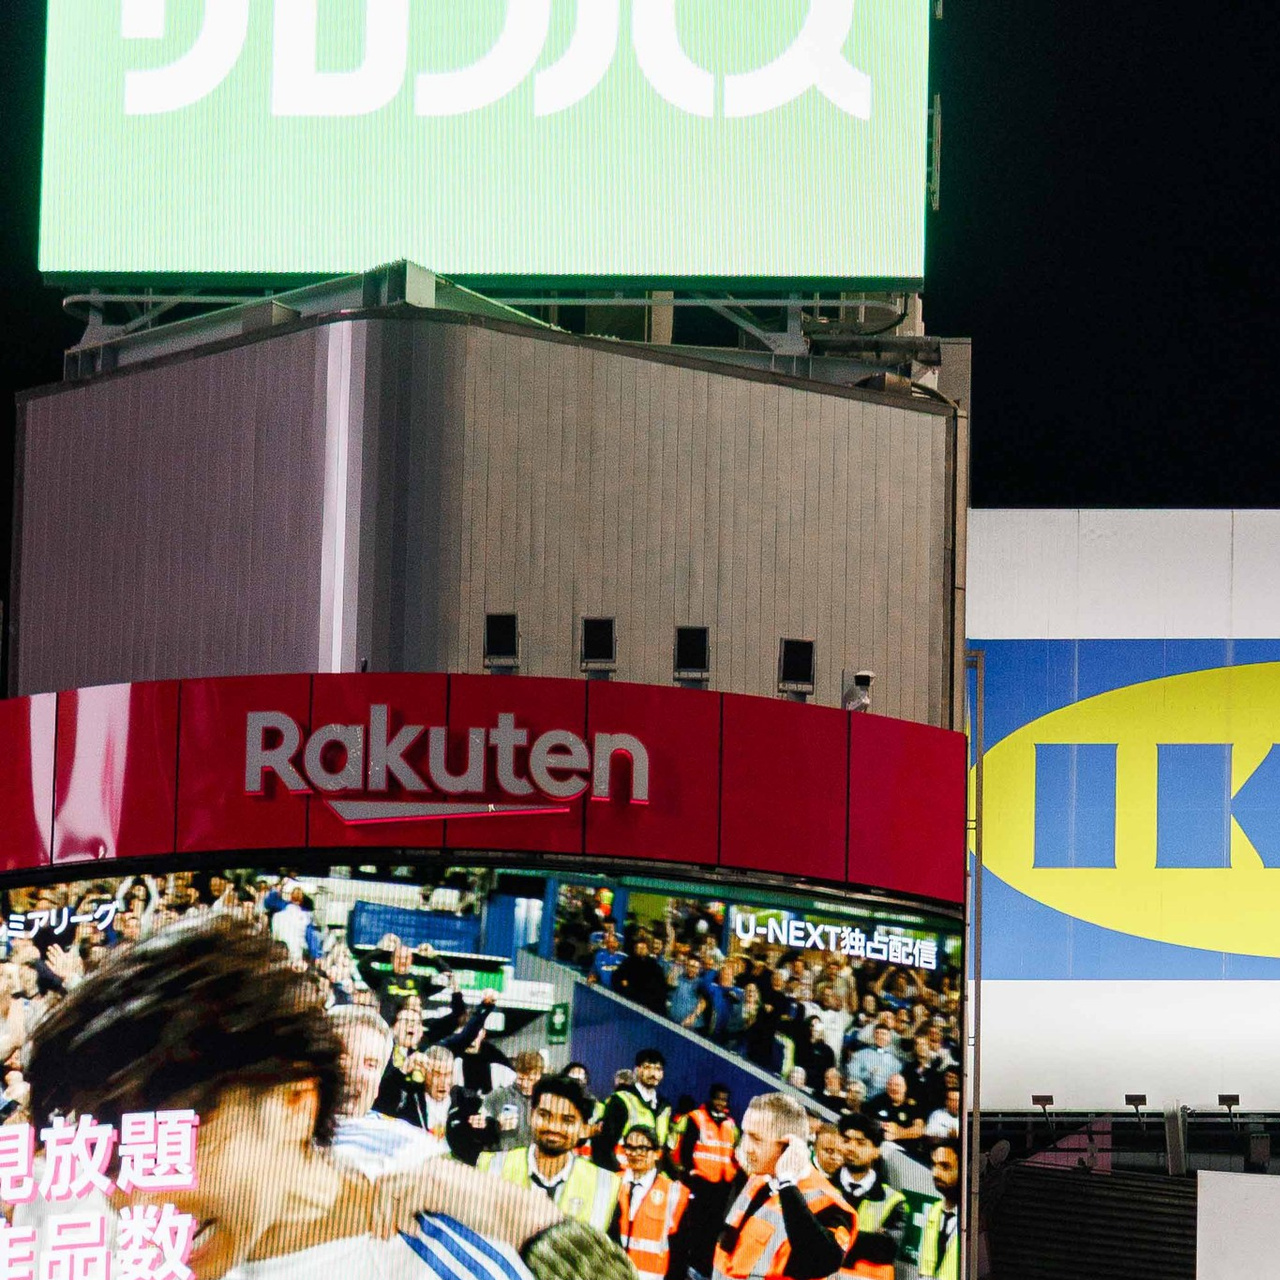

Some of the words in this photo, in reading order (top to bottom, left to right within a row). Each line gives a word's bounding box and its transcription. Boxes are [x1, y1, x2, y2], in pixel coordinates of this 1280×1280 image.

[245, 704, 649, 804] Rakuten
[0, 900, 120, 938] ミアリーグ
[735, 912, 938, 971] U-NEXT独占配信
